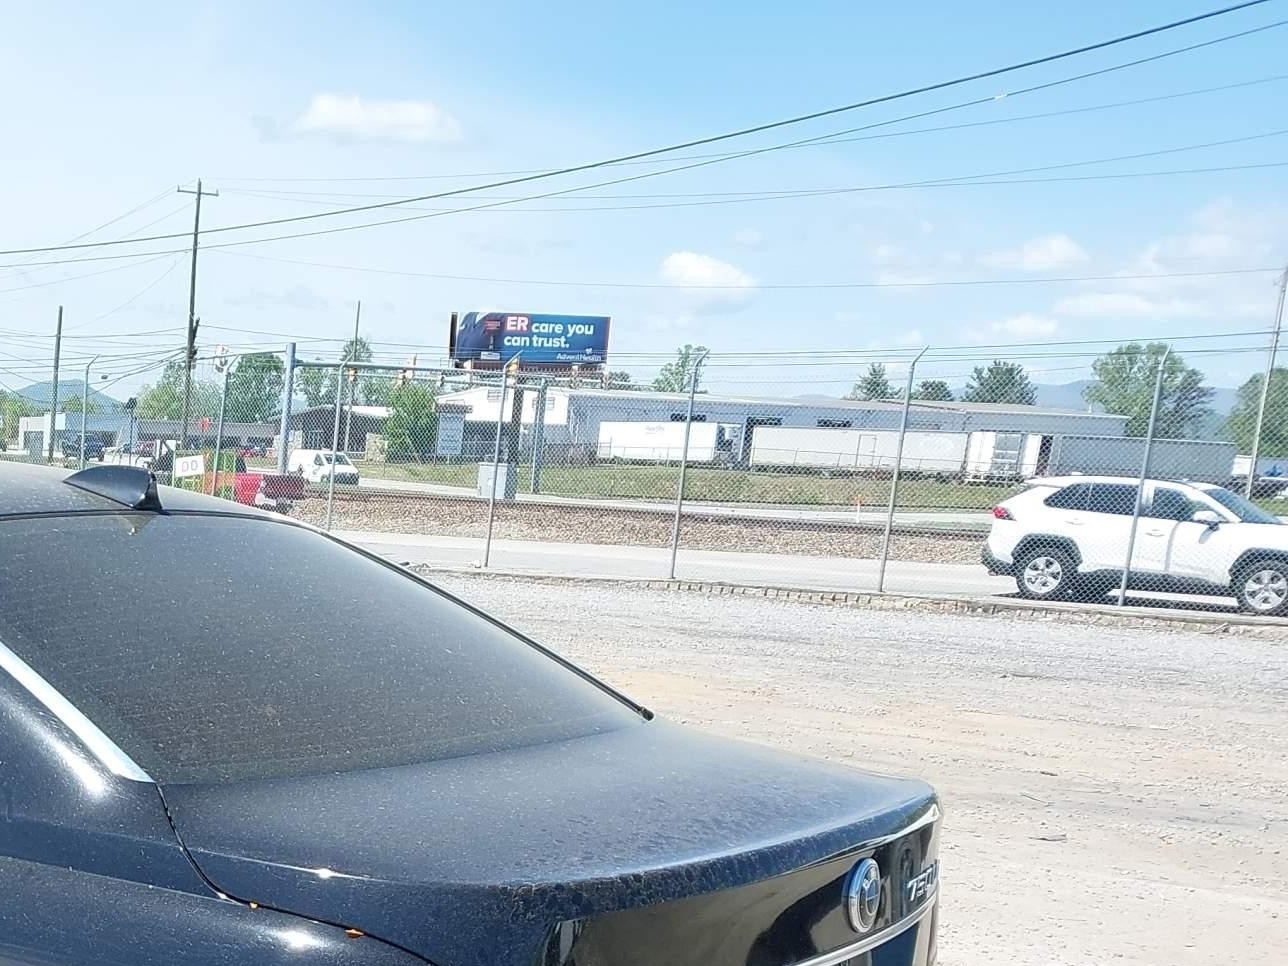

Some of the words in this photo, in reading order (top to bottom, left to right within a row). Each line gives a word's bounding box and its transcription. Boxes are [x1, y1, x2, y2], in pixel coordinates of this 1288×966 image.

[506, 316, 529, 331] ER
[532, 322, 563, 334] care
[567, 324, 594, 338] you
[503, 335, 530, 347] can
[532, 335, 570, 348] trust.
